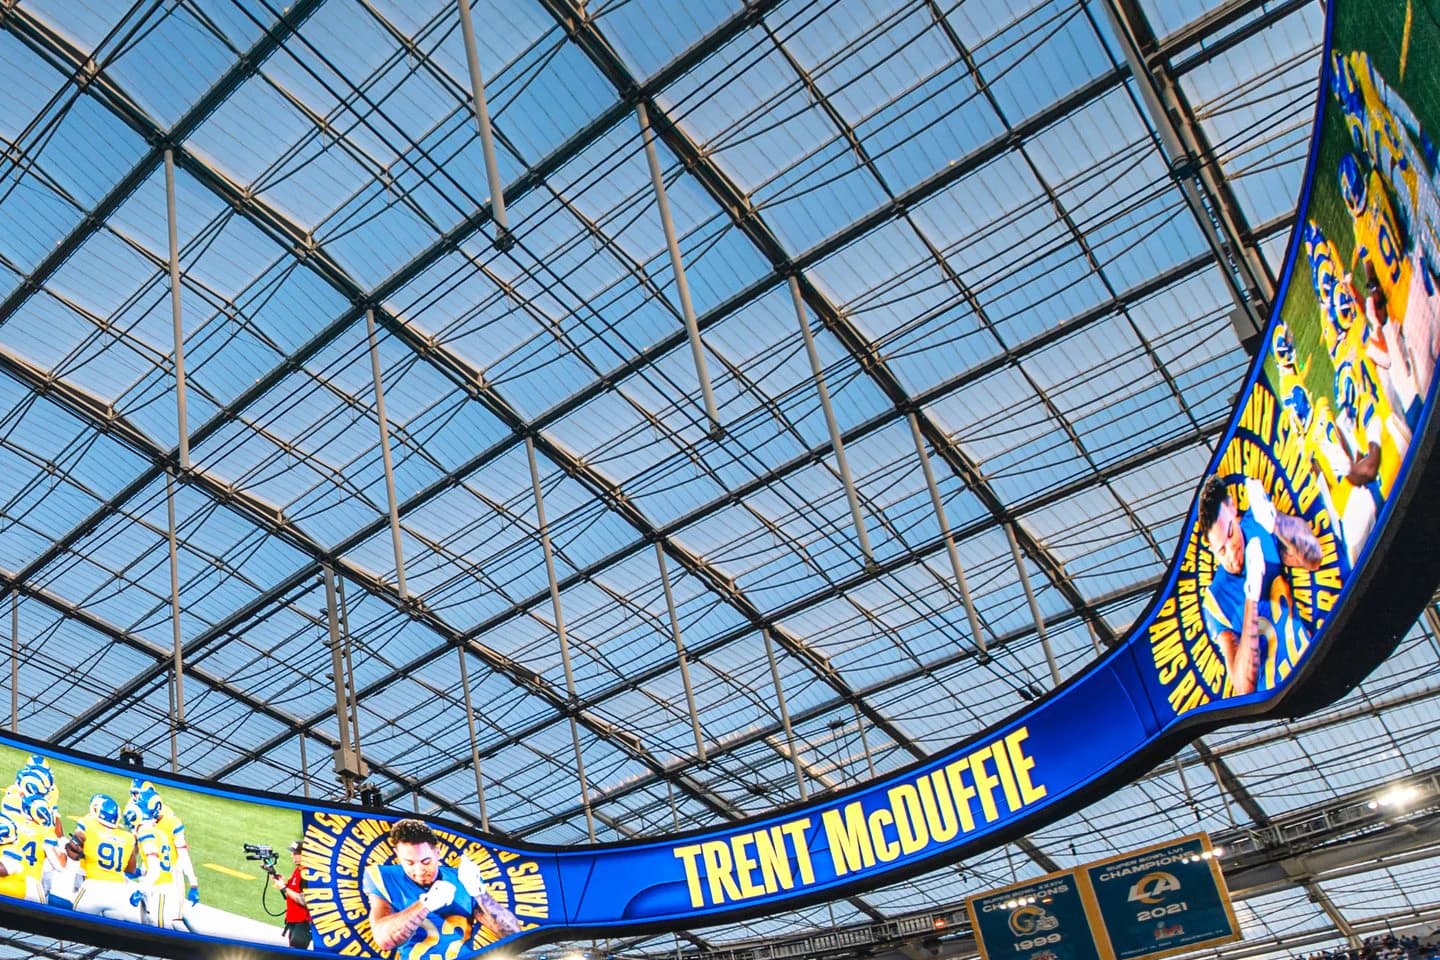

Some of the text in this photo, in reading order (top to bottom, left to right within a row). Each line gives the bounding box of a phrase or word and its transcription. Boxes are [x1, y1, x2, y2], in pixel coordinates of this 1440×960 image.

[673, 726, 1047, 908] TRENT McDUFFIE
[97, 842, 124, 875] 91
[301, 824, 338, 884] RAMS
[336, 836, 366, 878] RAMS
[336, 879, 368, 920] RAMS
[506, 861, 549, 919] RAMS
[302, 887, 352, 948] RAMS
[1136, 902, 1189, 922] 2021
[1013, 932, 1062, 952] 1999
